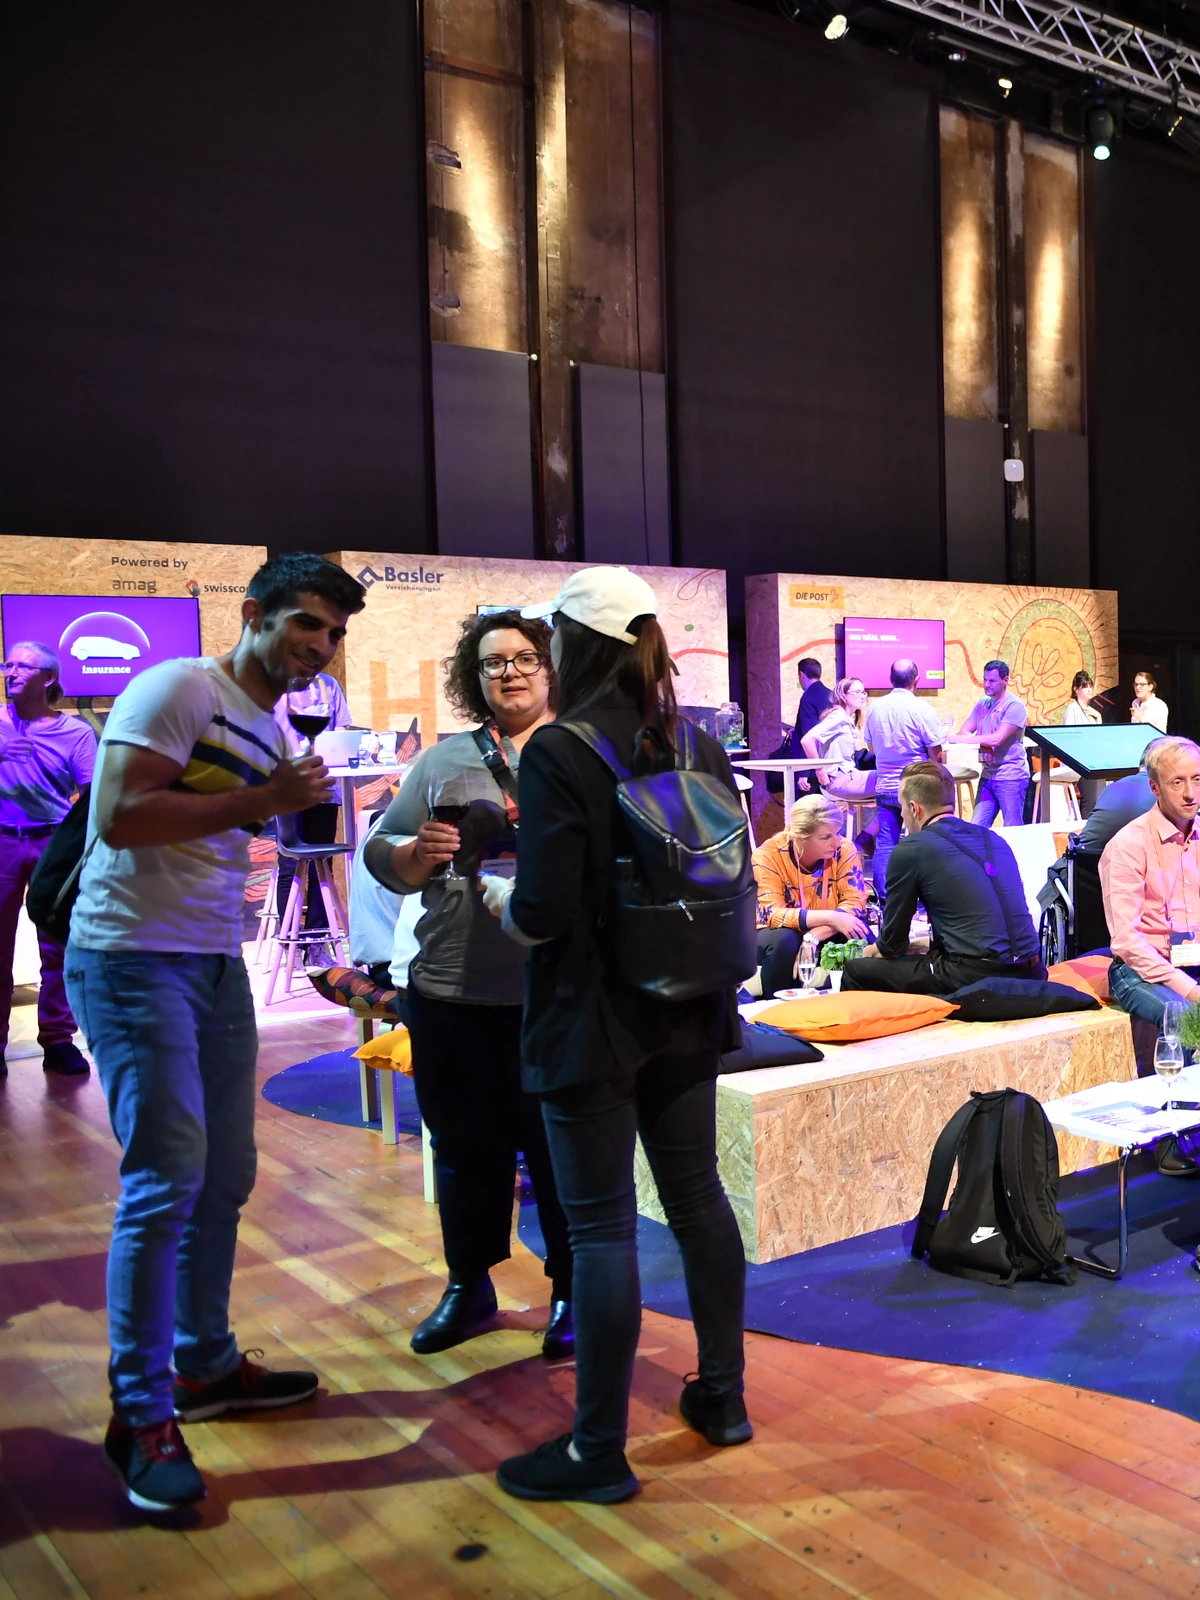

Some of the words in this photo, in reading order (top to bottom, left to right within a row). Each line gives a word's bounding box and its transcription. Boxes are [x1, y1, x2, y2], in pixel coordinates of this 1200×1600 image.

[111, 556, 169, 568] Powered
[173, 559, 188, 570] by
[384, 566, 444, 583] Basler
[112, 579, 157, 594] amag
[203, 582, 249, 594] swissco
[385, 584, 441, 593] Versicherungen
[795, 592, 808, 600] DIE
[809, 592, 829, 601] POST
[82, 664, 131, 674] insurance
